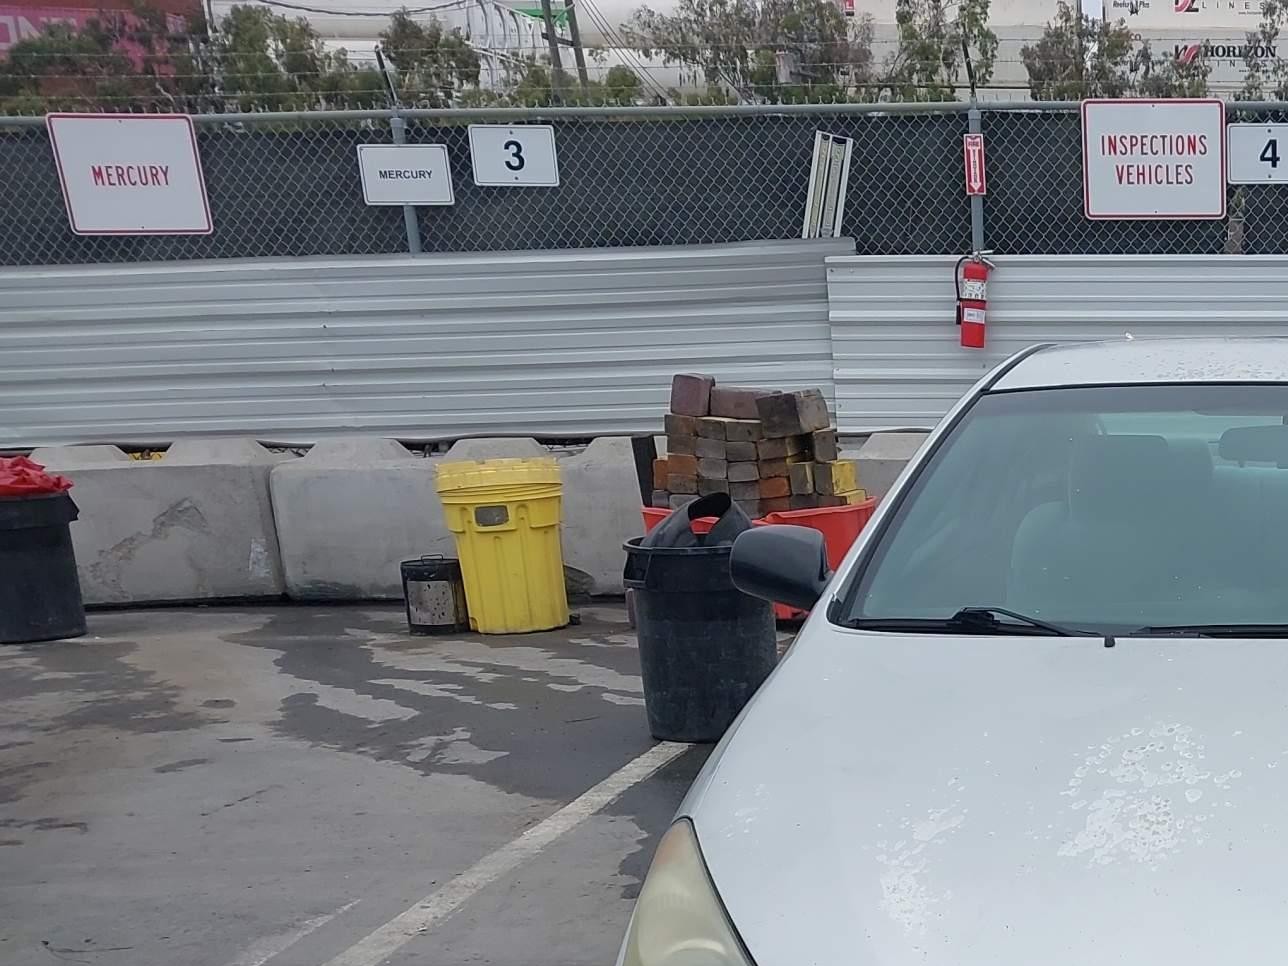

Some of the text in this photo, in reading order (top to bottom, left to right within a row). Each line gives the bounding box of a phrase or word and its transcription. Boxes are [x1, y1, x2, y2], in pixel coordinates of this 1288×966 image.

[1204, 45, 1277, 58] HORIZON
[503, 140, 525, 172] 3
[1101, 135, 1208, 156] INSPECTIONS
[1259, 139, 1280, 169] 4
[91, 165, 169, 186] MERCURY
[378, 169, 432, 180] MERCURY
[1116, 164, 1194, 185] VEHICLES
